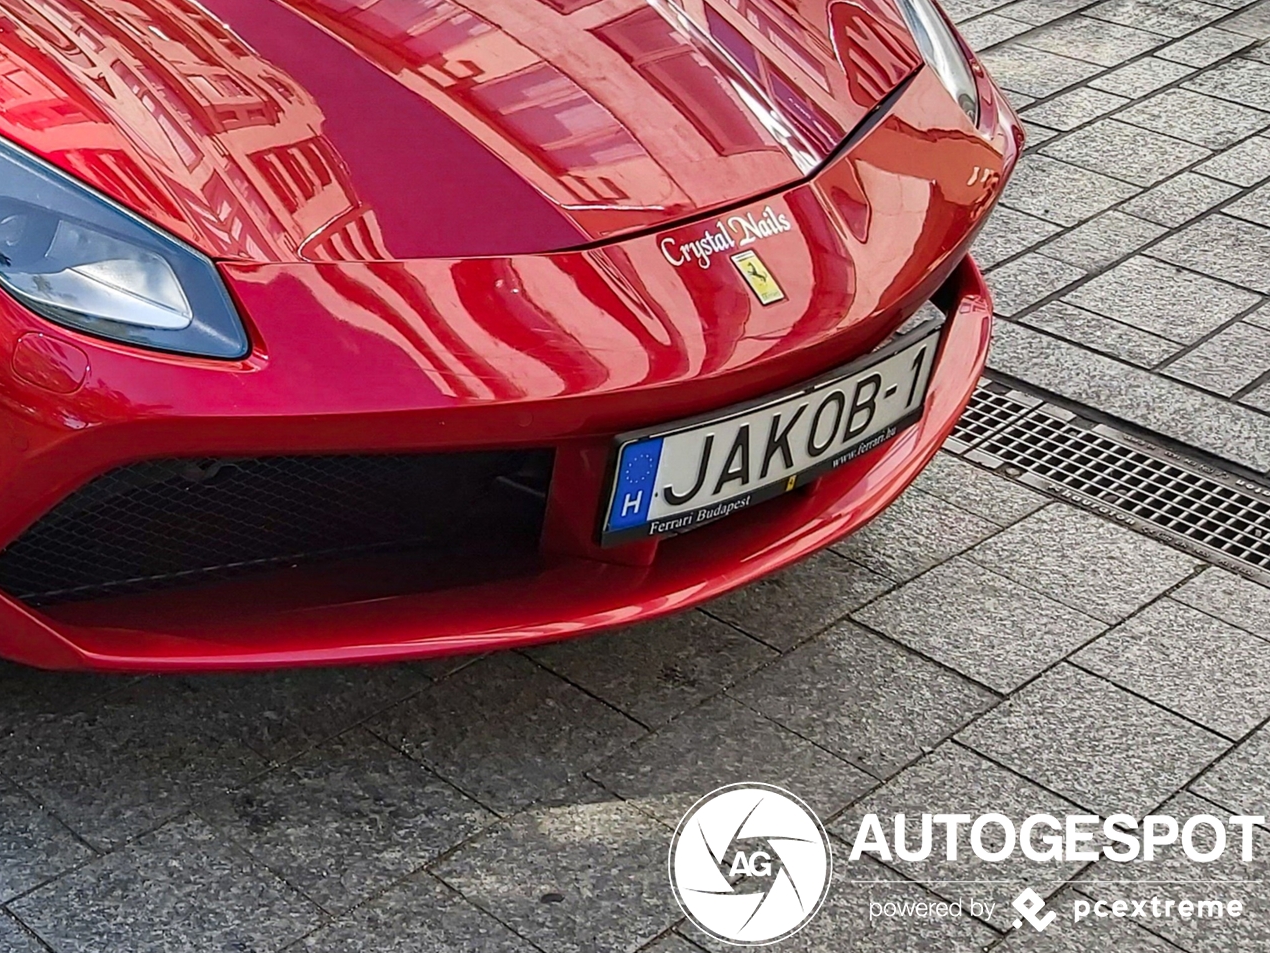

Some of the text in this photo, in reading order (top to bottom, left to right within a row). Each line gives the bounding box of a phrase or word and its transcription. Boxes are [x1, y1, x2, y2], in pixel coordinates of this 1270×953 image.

[660, 205, 791, 269] Crystal Nails
[663, 345, 928, 507] JAKOB-1
[832, 427, 897, 468] www.ferrari.hu
[621, 490, 644, 517] H
[649, 495, 751, 535] Ferrari Budapest
